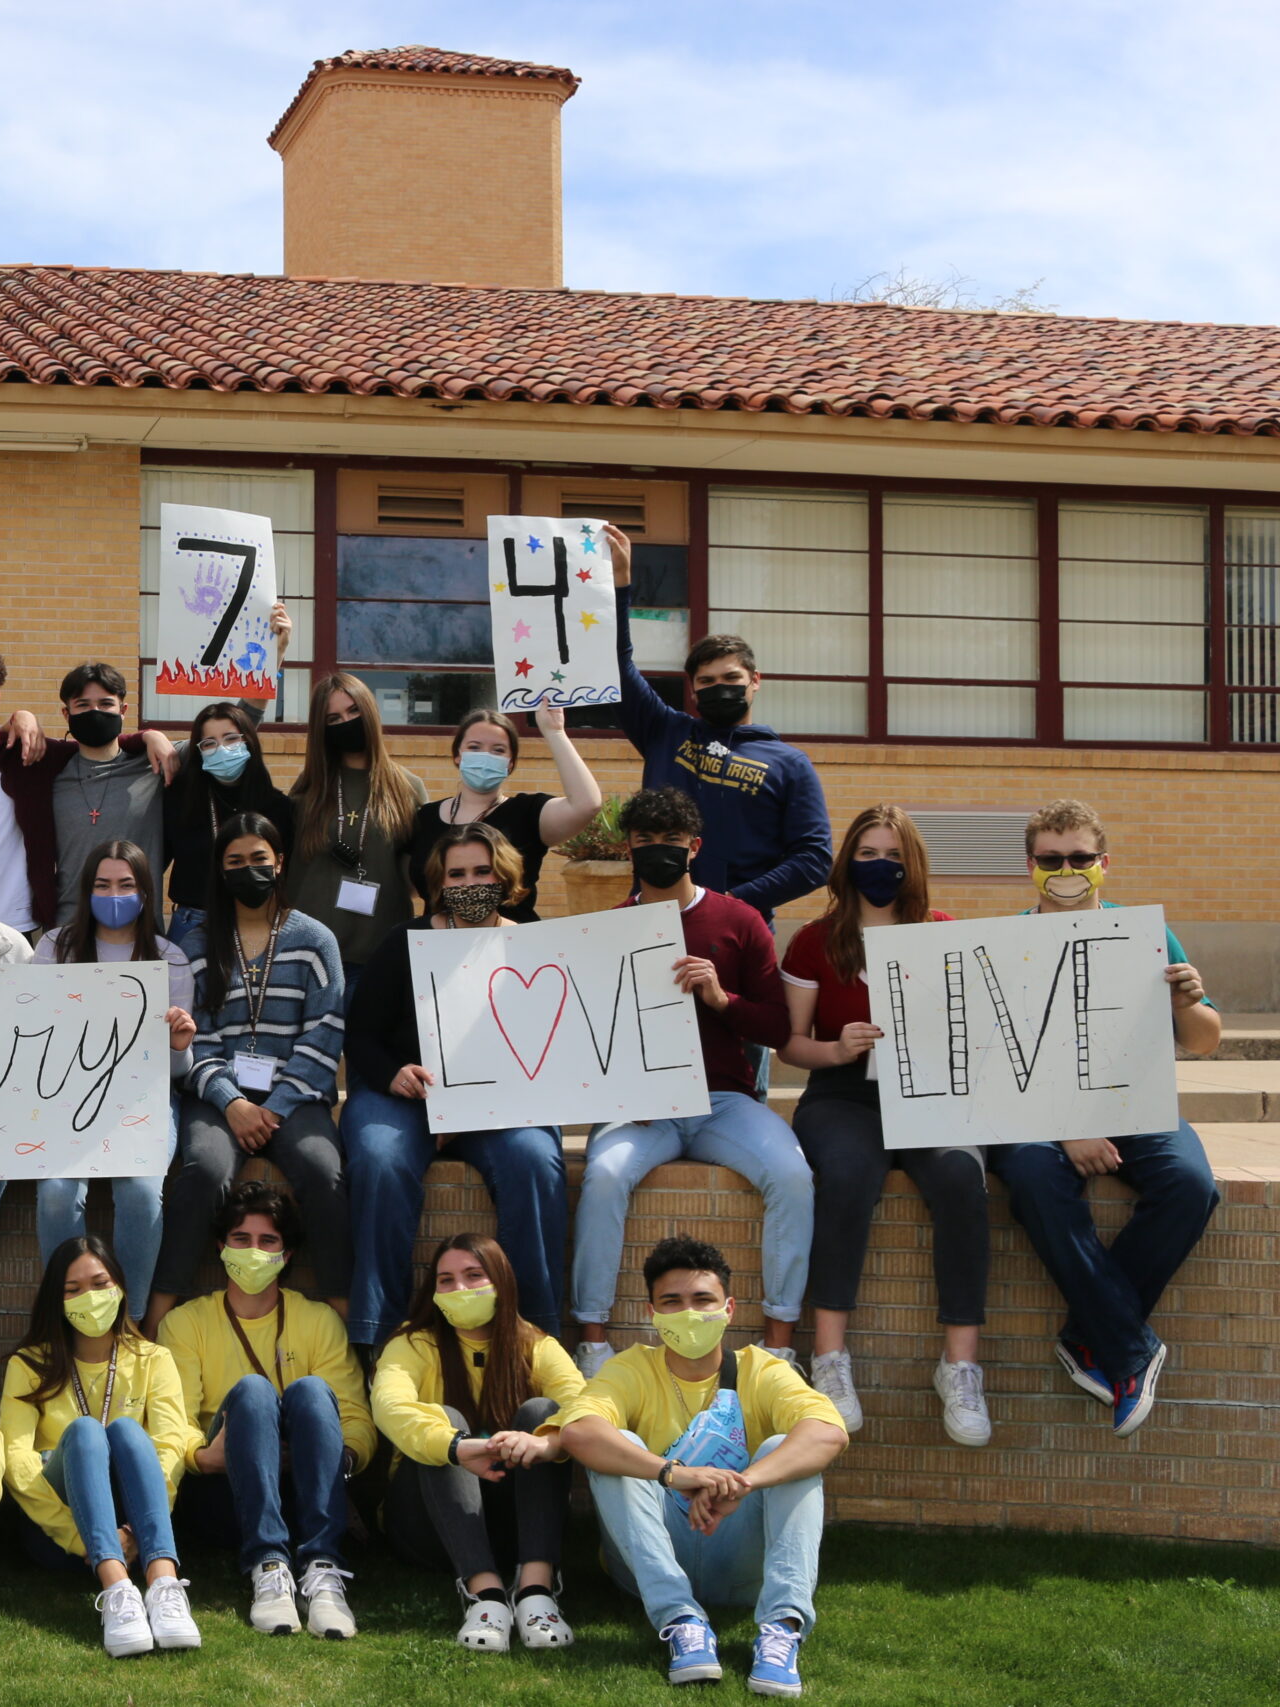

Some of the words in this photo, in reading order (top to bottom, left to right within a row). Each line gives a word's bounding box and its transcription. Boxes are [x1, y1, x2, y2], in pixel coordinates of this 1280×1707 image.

[177, 537, 257, 667] 7
[504, 536, 570, 664] 4
[726, 762, 766, 785] IRISH
[886, 936, 1130, 1098] LIVE
